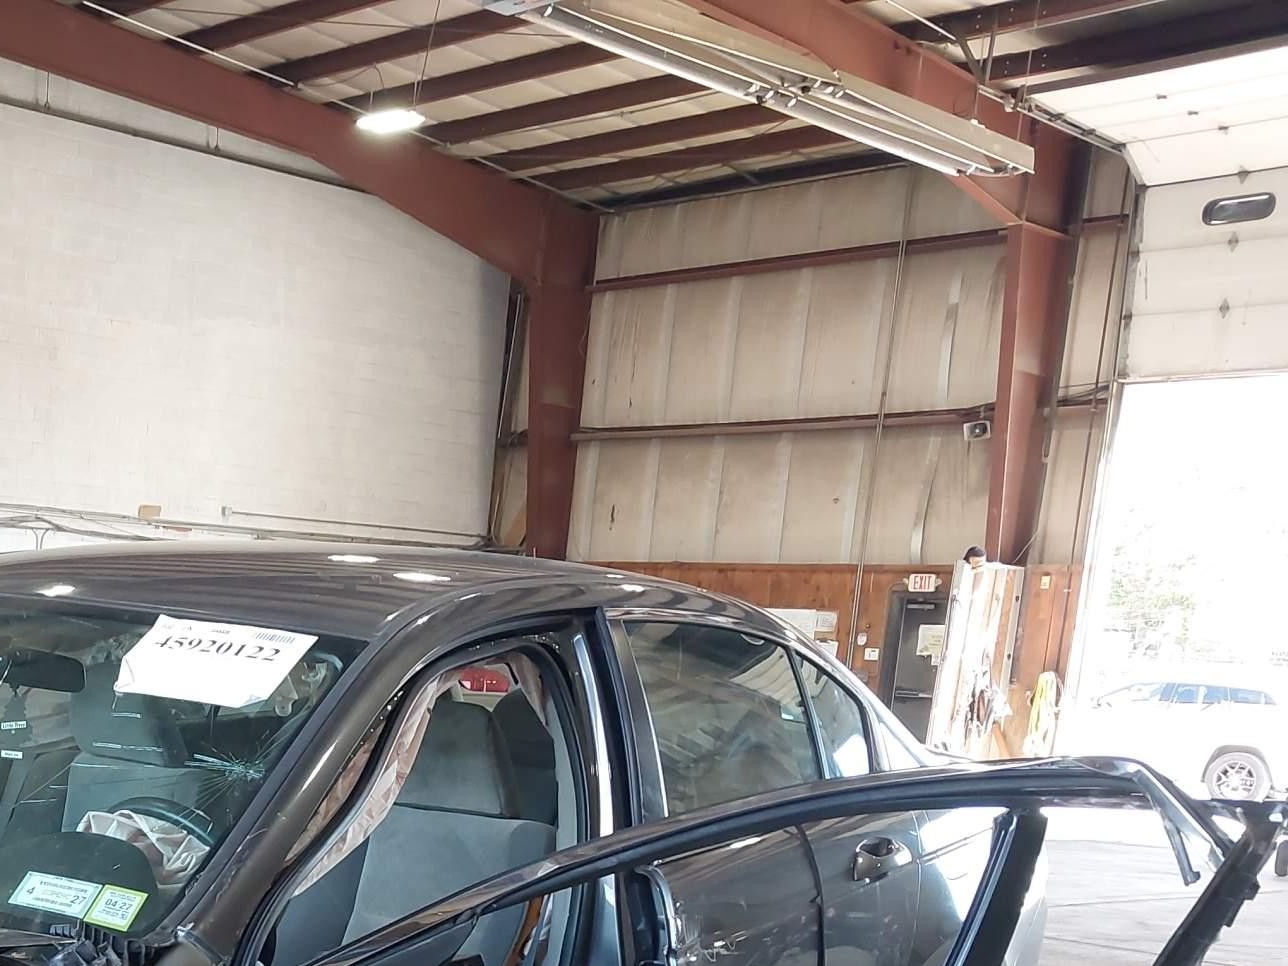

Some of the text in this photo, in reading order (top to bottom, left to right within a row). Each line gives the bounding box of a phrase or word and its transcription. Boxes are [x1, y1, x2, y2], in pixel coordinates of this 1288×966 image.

[913, 575, 933, 590] EXIT
[154, 635, 281, 662] 45920122
[70, 895, 88, 905] 27
